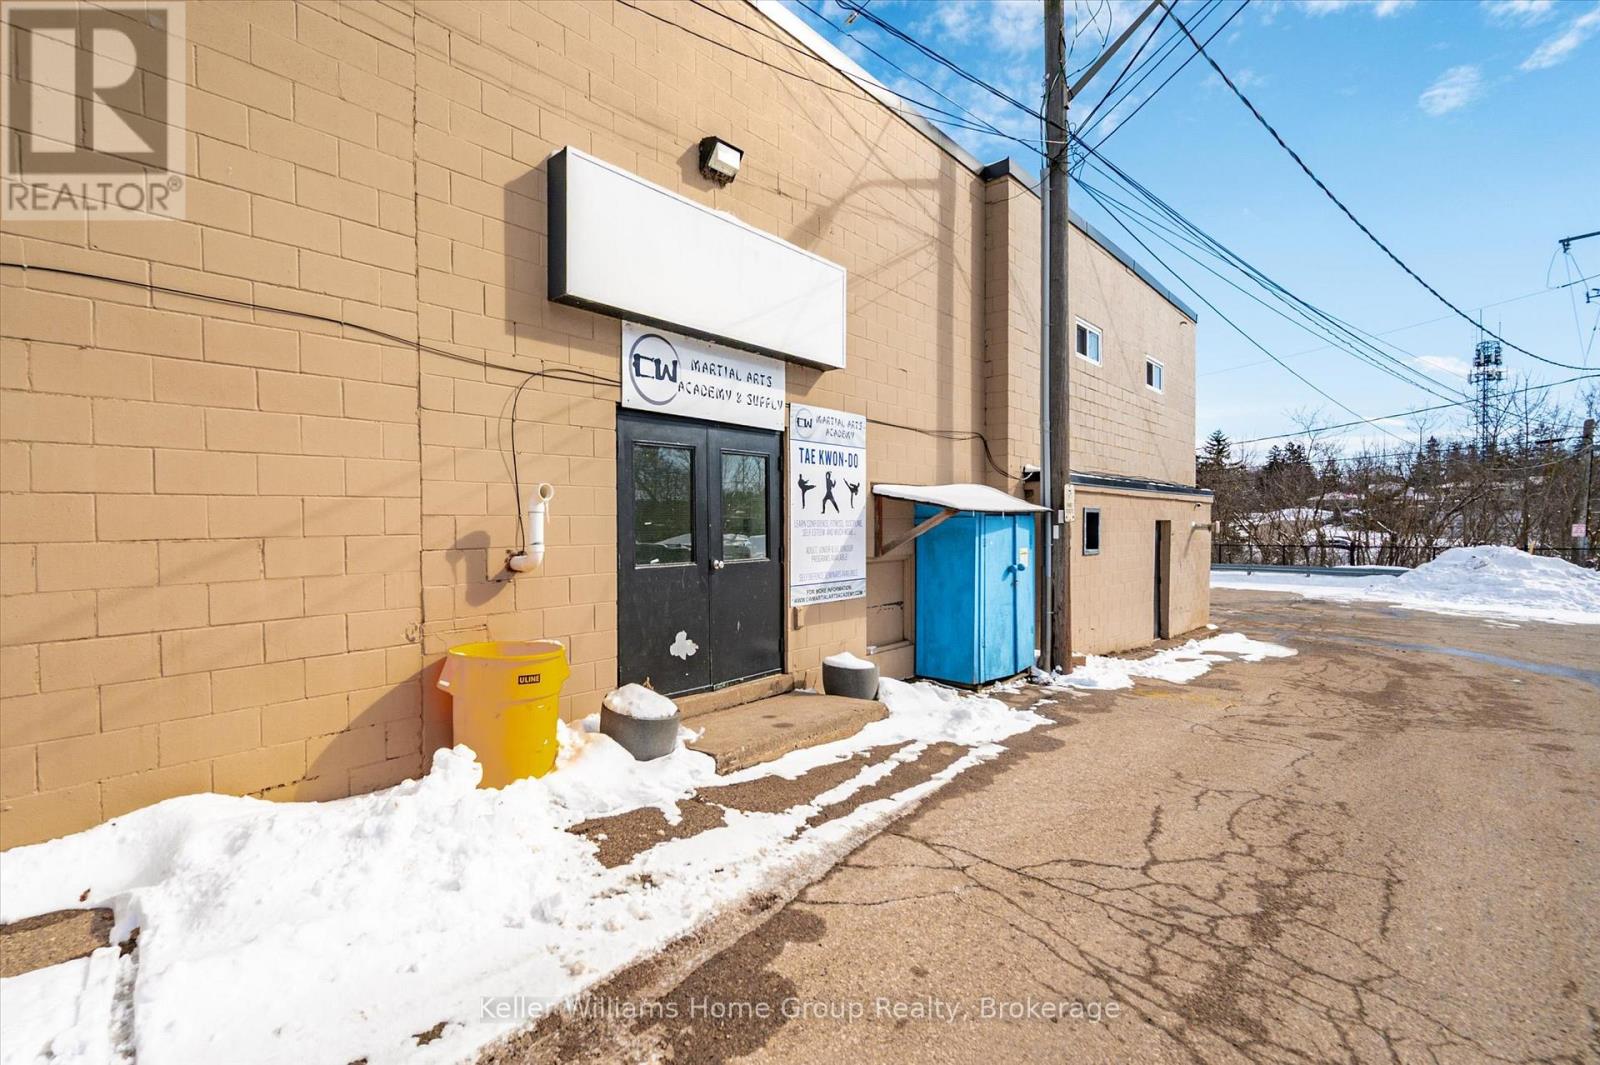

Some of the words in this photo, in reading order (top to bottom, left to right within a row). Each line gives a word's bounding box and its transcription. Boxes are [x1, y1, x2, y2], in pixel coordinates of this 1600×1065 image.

[690, 359, 742, 382] MARTIAL
[746, 372, 773, 388] ARTS
[677, 381, 732, 401] ACADEMY
[736, 391, 741, 404] &
[815, 415, 845, 427] MARTIAL
[847, 419, 863, 431] ARTS
[825, 428, 855, 440] ACADEMY
[799, 447, 816, 465] TAE
[818, 449, 859, 468] KWON-DO
[519, 675, 540, 684] ULINE
